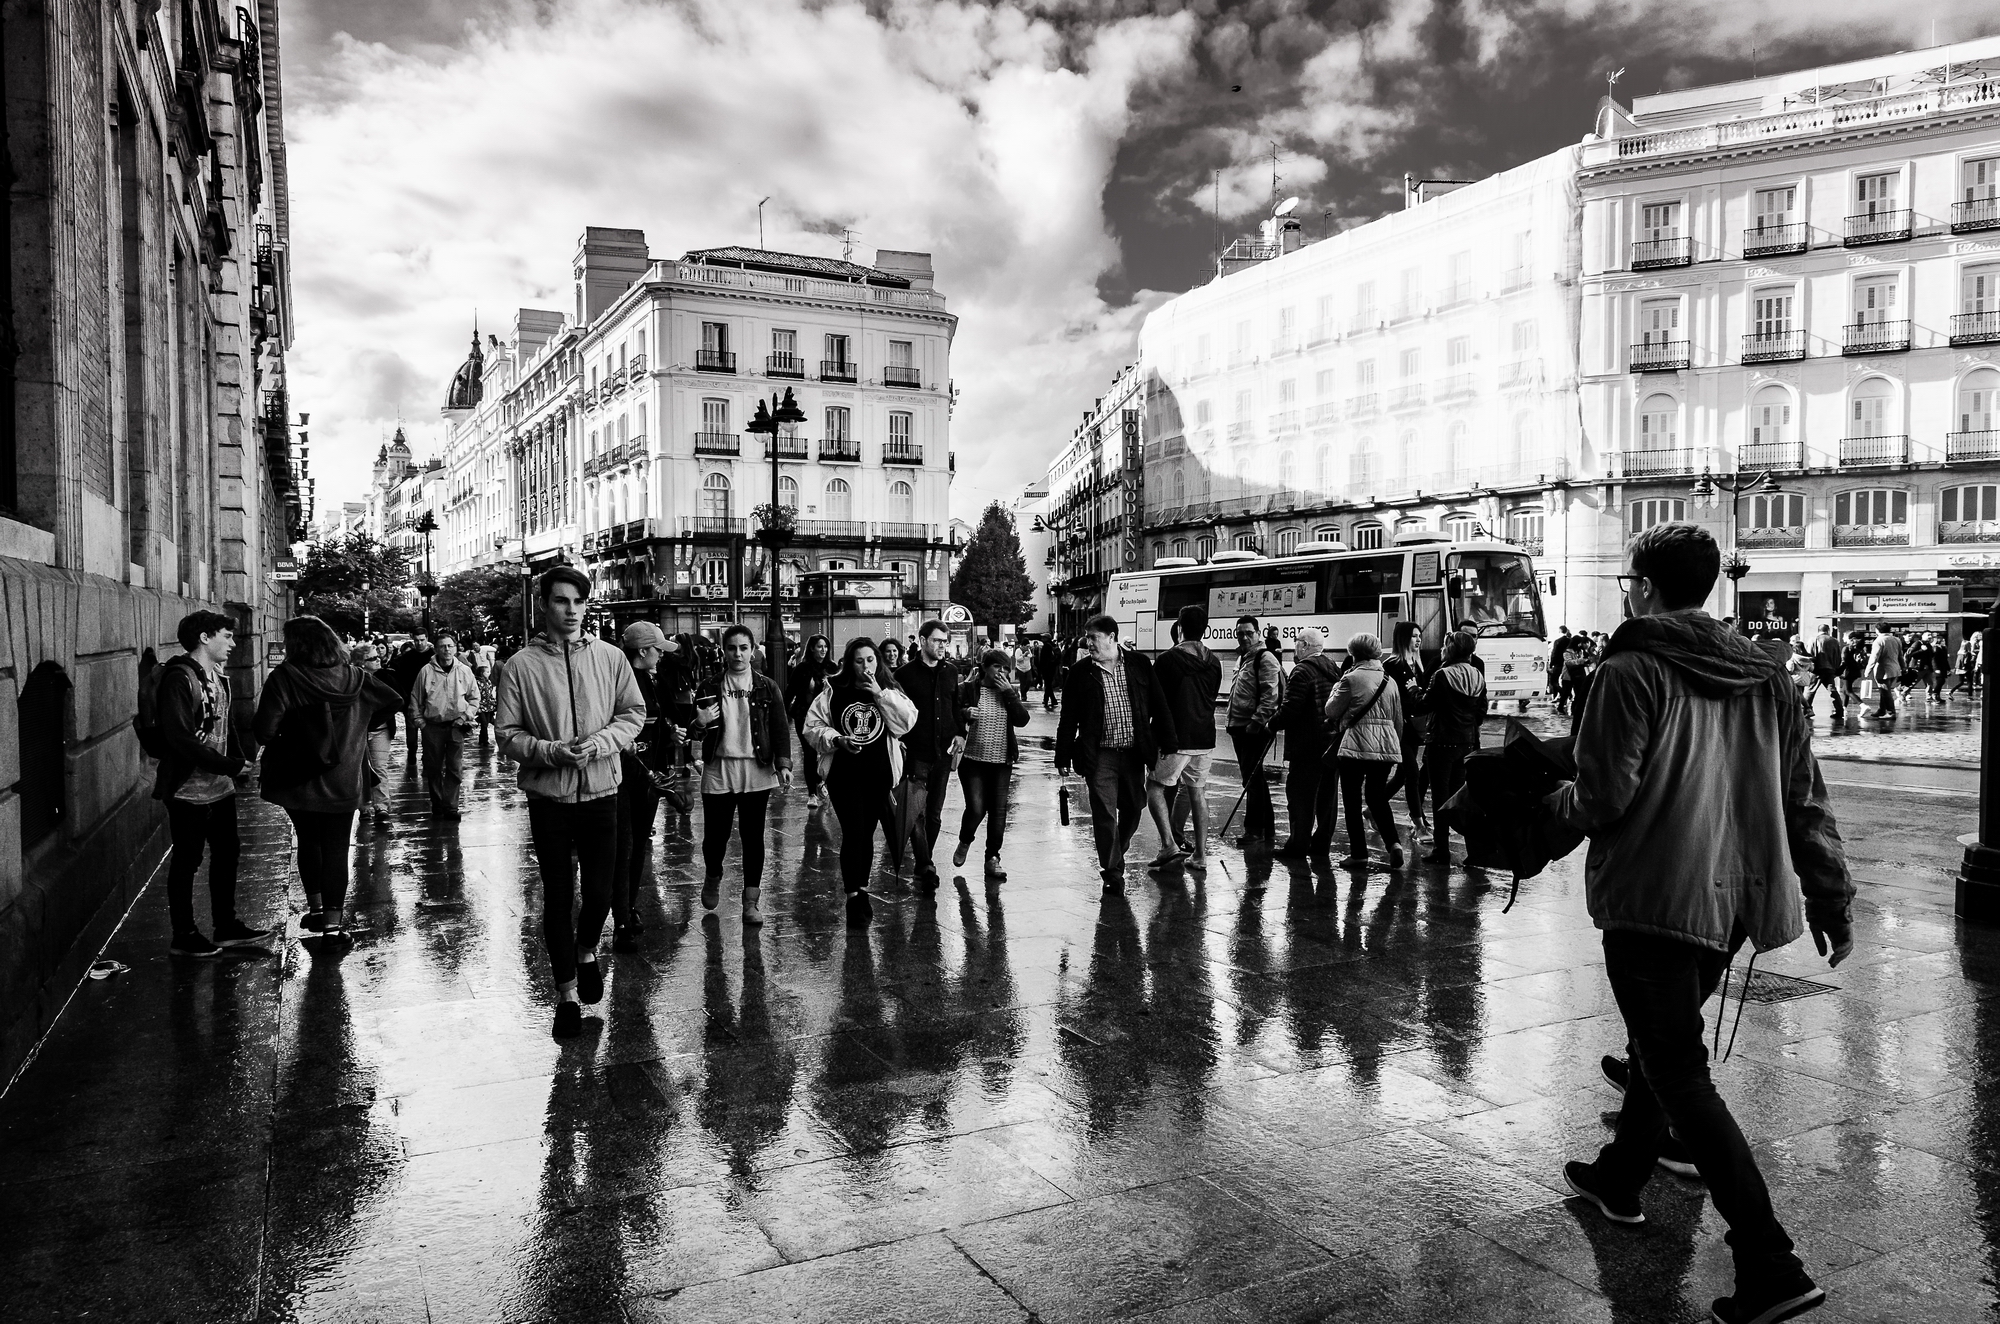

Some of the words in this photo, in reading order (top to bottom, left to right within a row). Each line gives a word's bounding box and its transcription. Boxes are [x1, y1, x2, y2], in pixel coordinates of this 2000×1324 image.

[1124, 410, 1137, 471] HOTEL
[1123, 479, 1137, 562] MODERNO
[1203, 625, 1260, 640] Donac
[1748, 621, 1763, 630] DO
[1765, 621, 1788, 630] YOU
